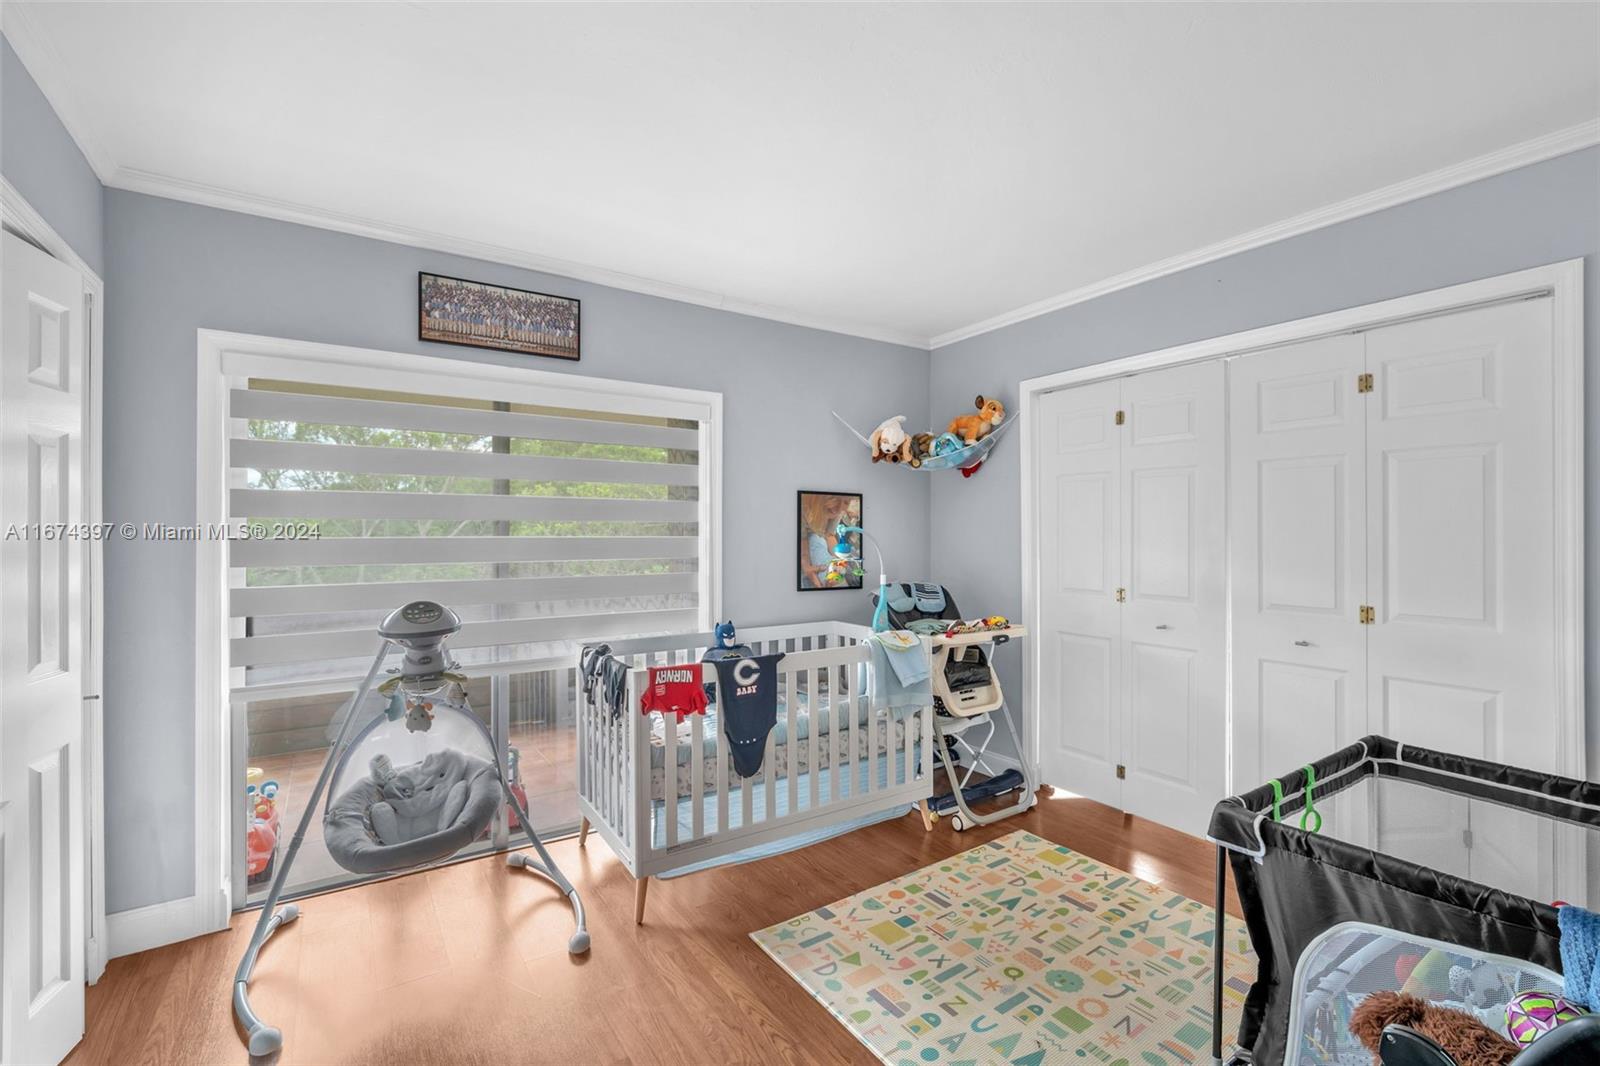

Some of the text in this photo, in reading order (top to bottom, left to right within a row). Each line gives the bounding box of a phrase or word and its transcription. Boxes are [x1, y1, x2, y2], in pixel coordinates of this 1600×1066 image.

[734, 659, 761, 687] C
[736, 685, 758, 697] BABY
[812, 961, 838, 976] D
[937, 1031, 968, 1054] A
